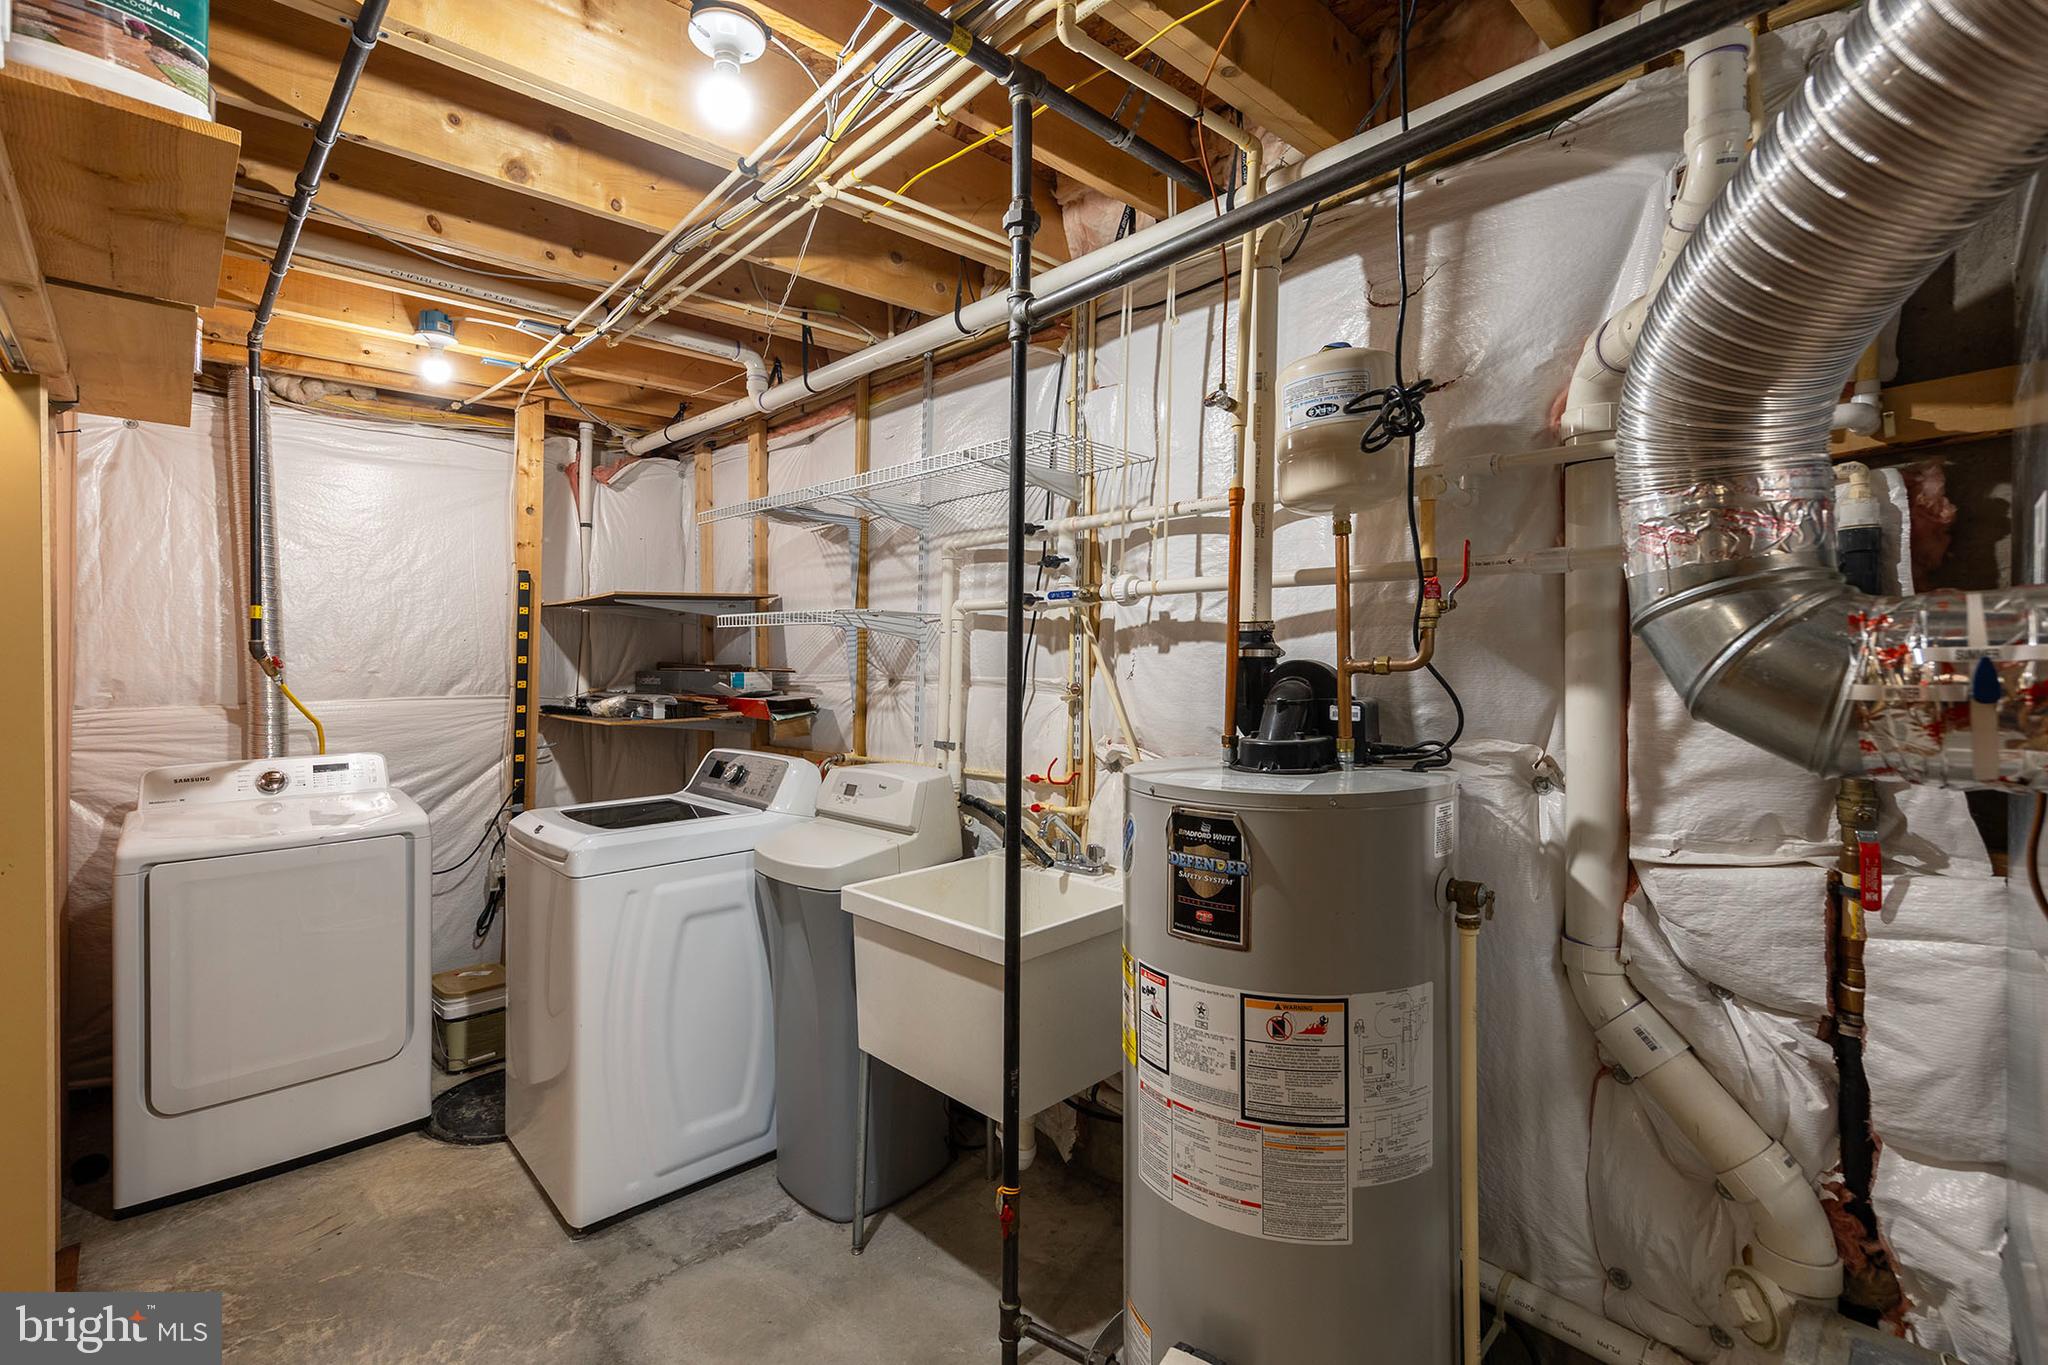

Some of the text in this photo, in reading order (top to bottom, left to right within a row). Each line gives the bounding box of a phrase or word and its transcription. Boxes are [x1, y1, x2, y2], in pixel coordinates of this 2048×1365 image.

[140, 0, 181, 20] EALER
[390, 269, 519, 305] CHARLOTTE PIPE
[173, 776, 210, 784] SAMSUNG
[1178, 828, 1212, 840] BRADFORD
[1212, 833, 1236, 842] WHITE
[1169, 850, 1249, 876] DEFENDER
